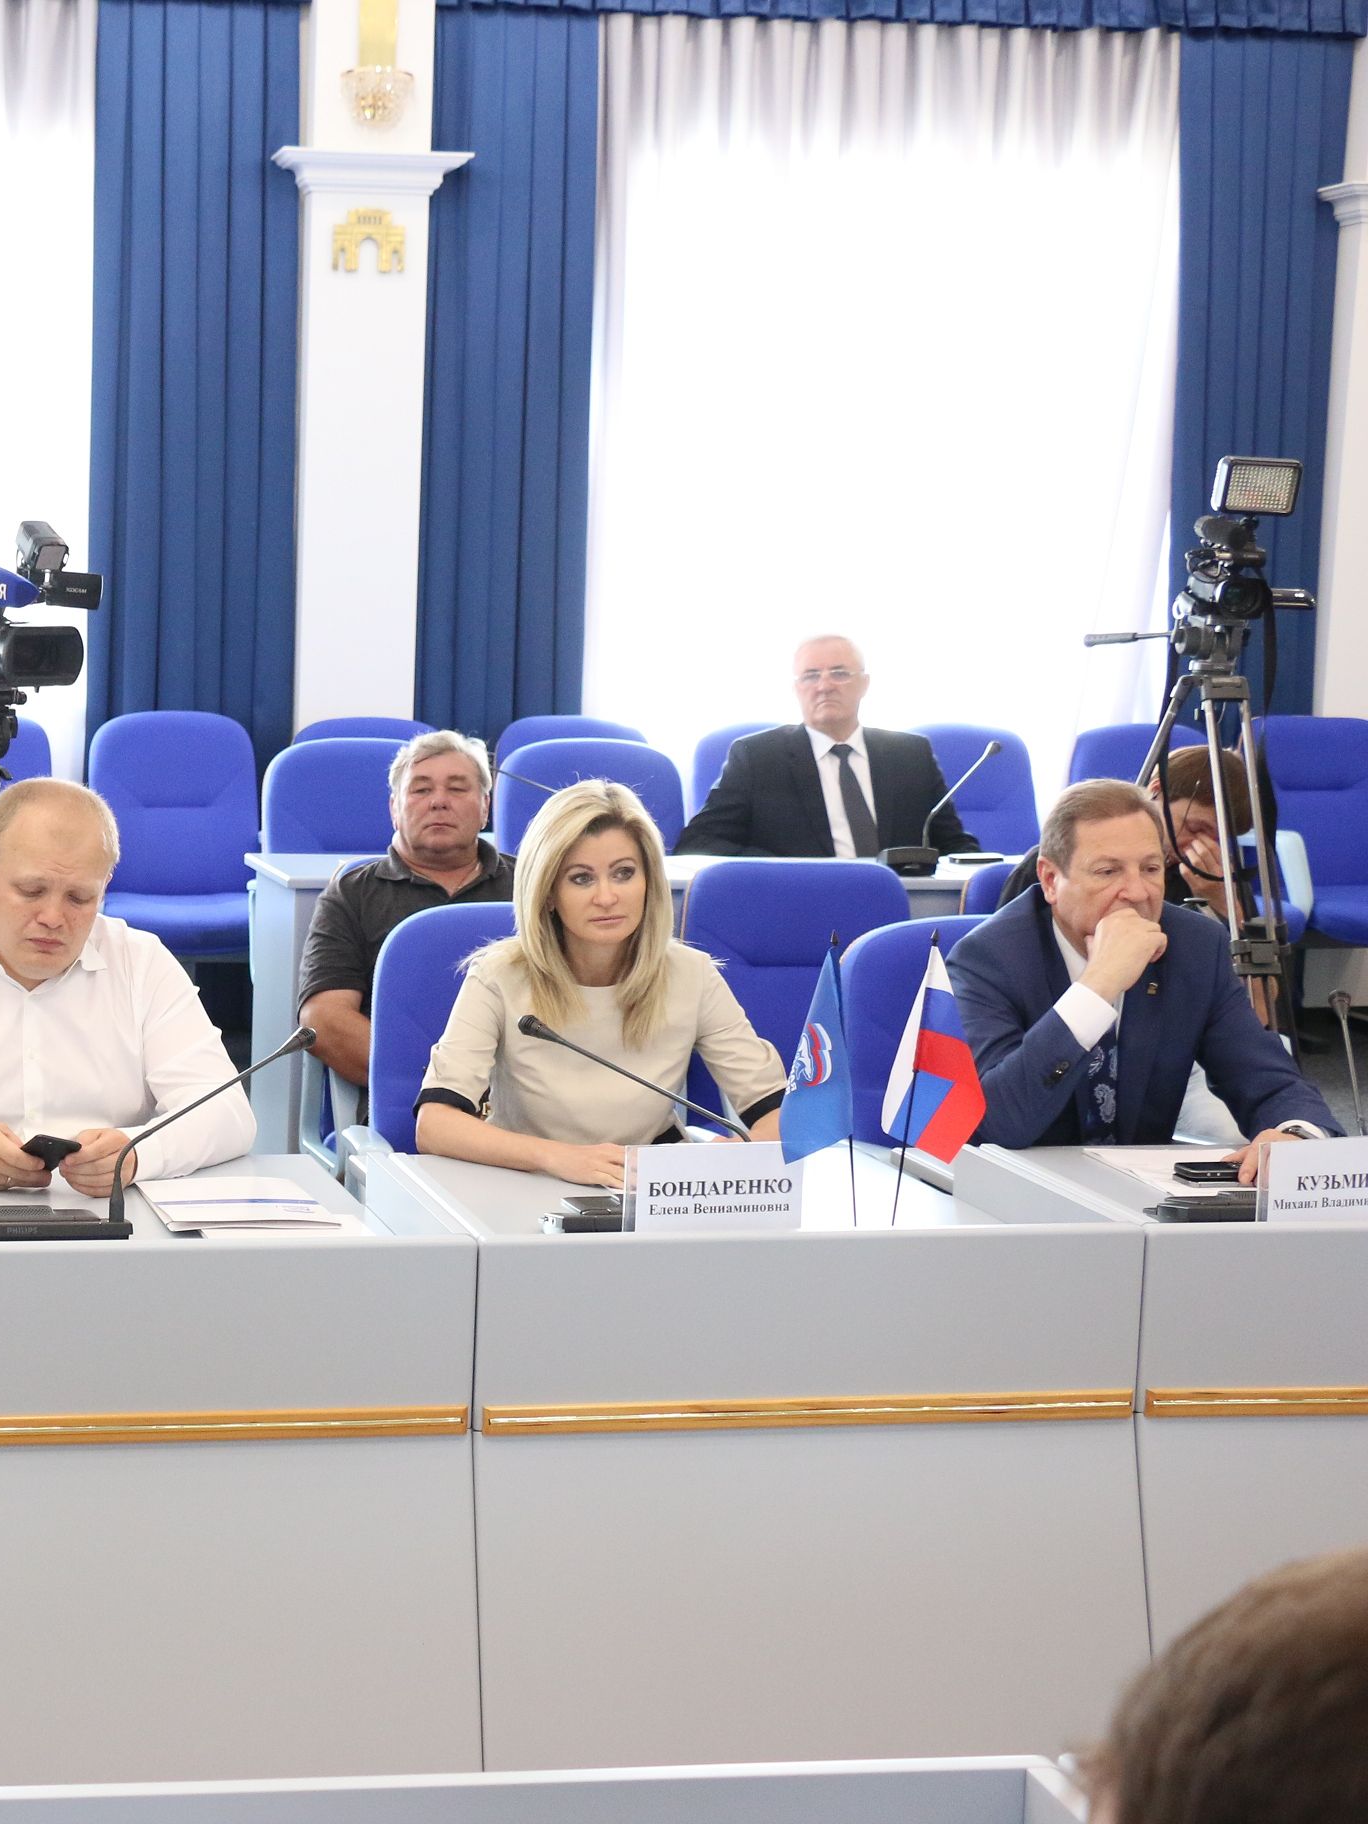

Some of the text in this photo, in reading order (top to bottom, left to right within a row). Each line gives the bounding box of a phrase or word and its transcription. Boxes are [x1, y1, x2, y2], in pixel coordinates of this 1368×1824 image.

[648, 1178, 793, 1199] БОНДАРЕНКО
[649, 1202, 790, 1216] Елена Вениаминовна
[1272, 1198, 1318, 1211] Михаил
